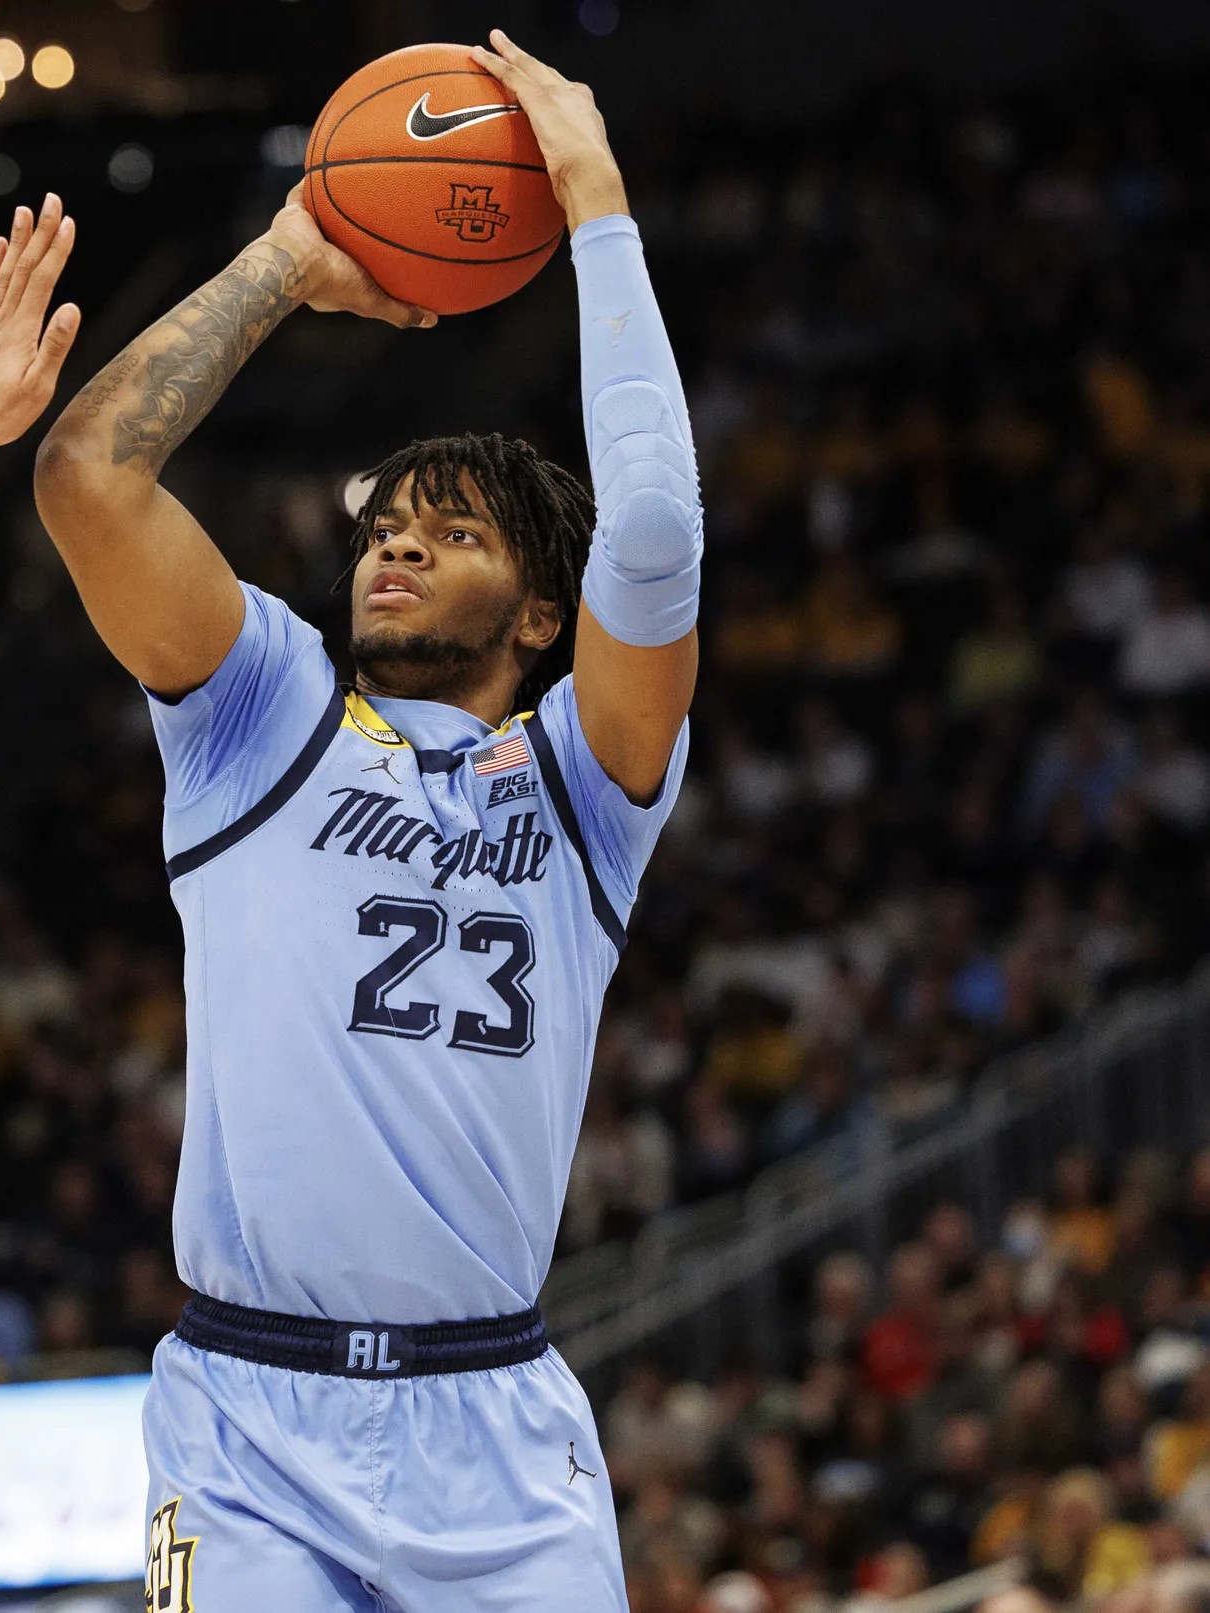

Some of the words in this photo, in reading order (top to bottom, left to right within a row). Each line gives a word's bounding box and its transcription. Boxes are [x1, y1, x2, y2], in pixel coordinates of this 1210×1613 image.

[489, 781, 539, 803] EAST
[491, 770, 528, 791] BIG
[309, 787, 554, 891] Marquette
[346, 893, 537, 1059] 23
[346, 1330, 401, 1371] AL
